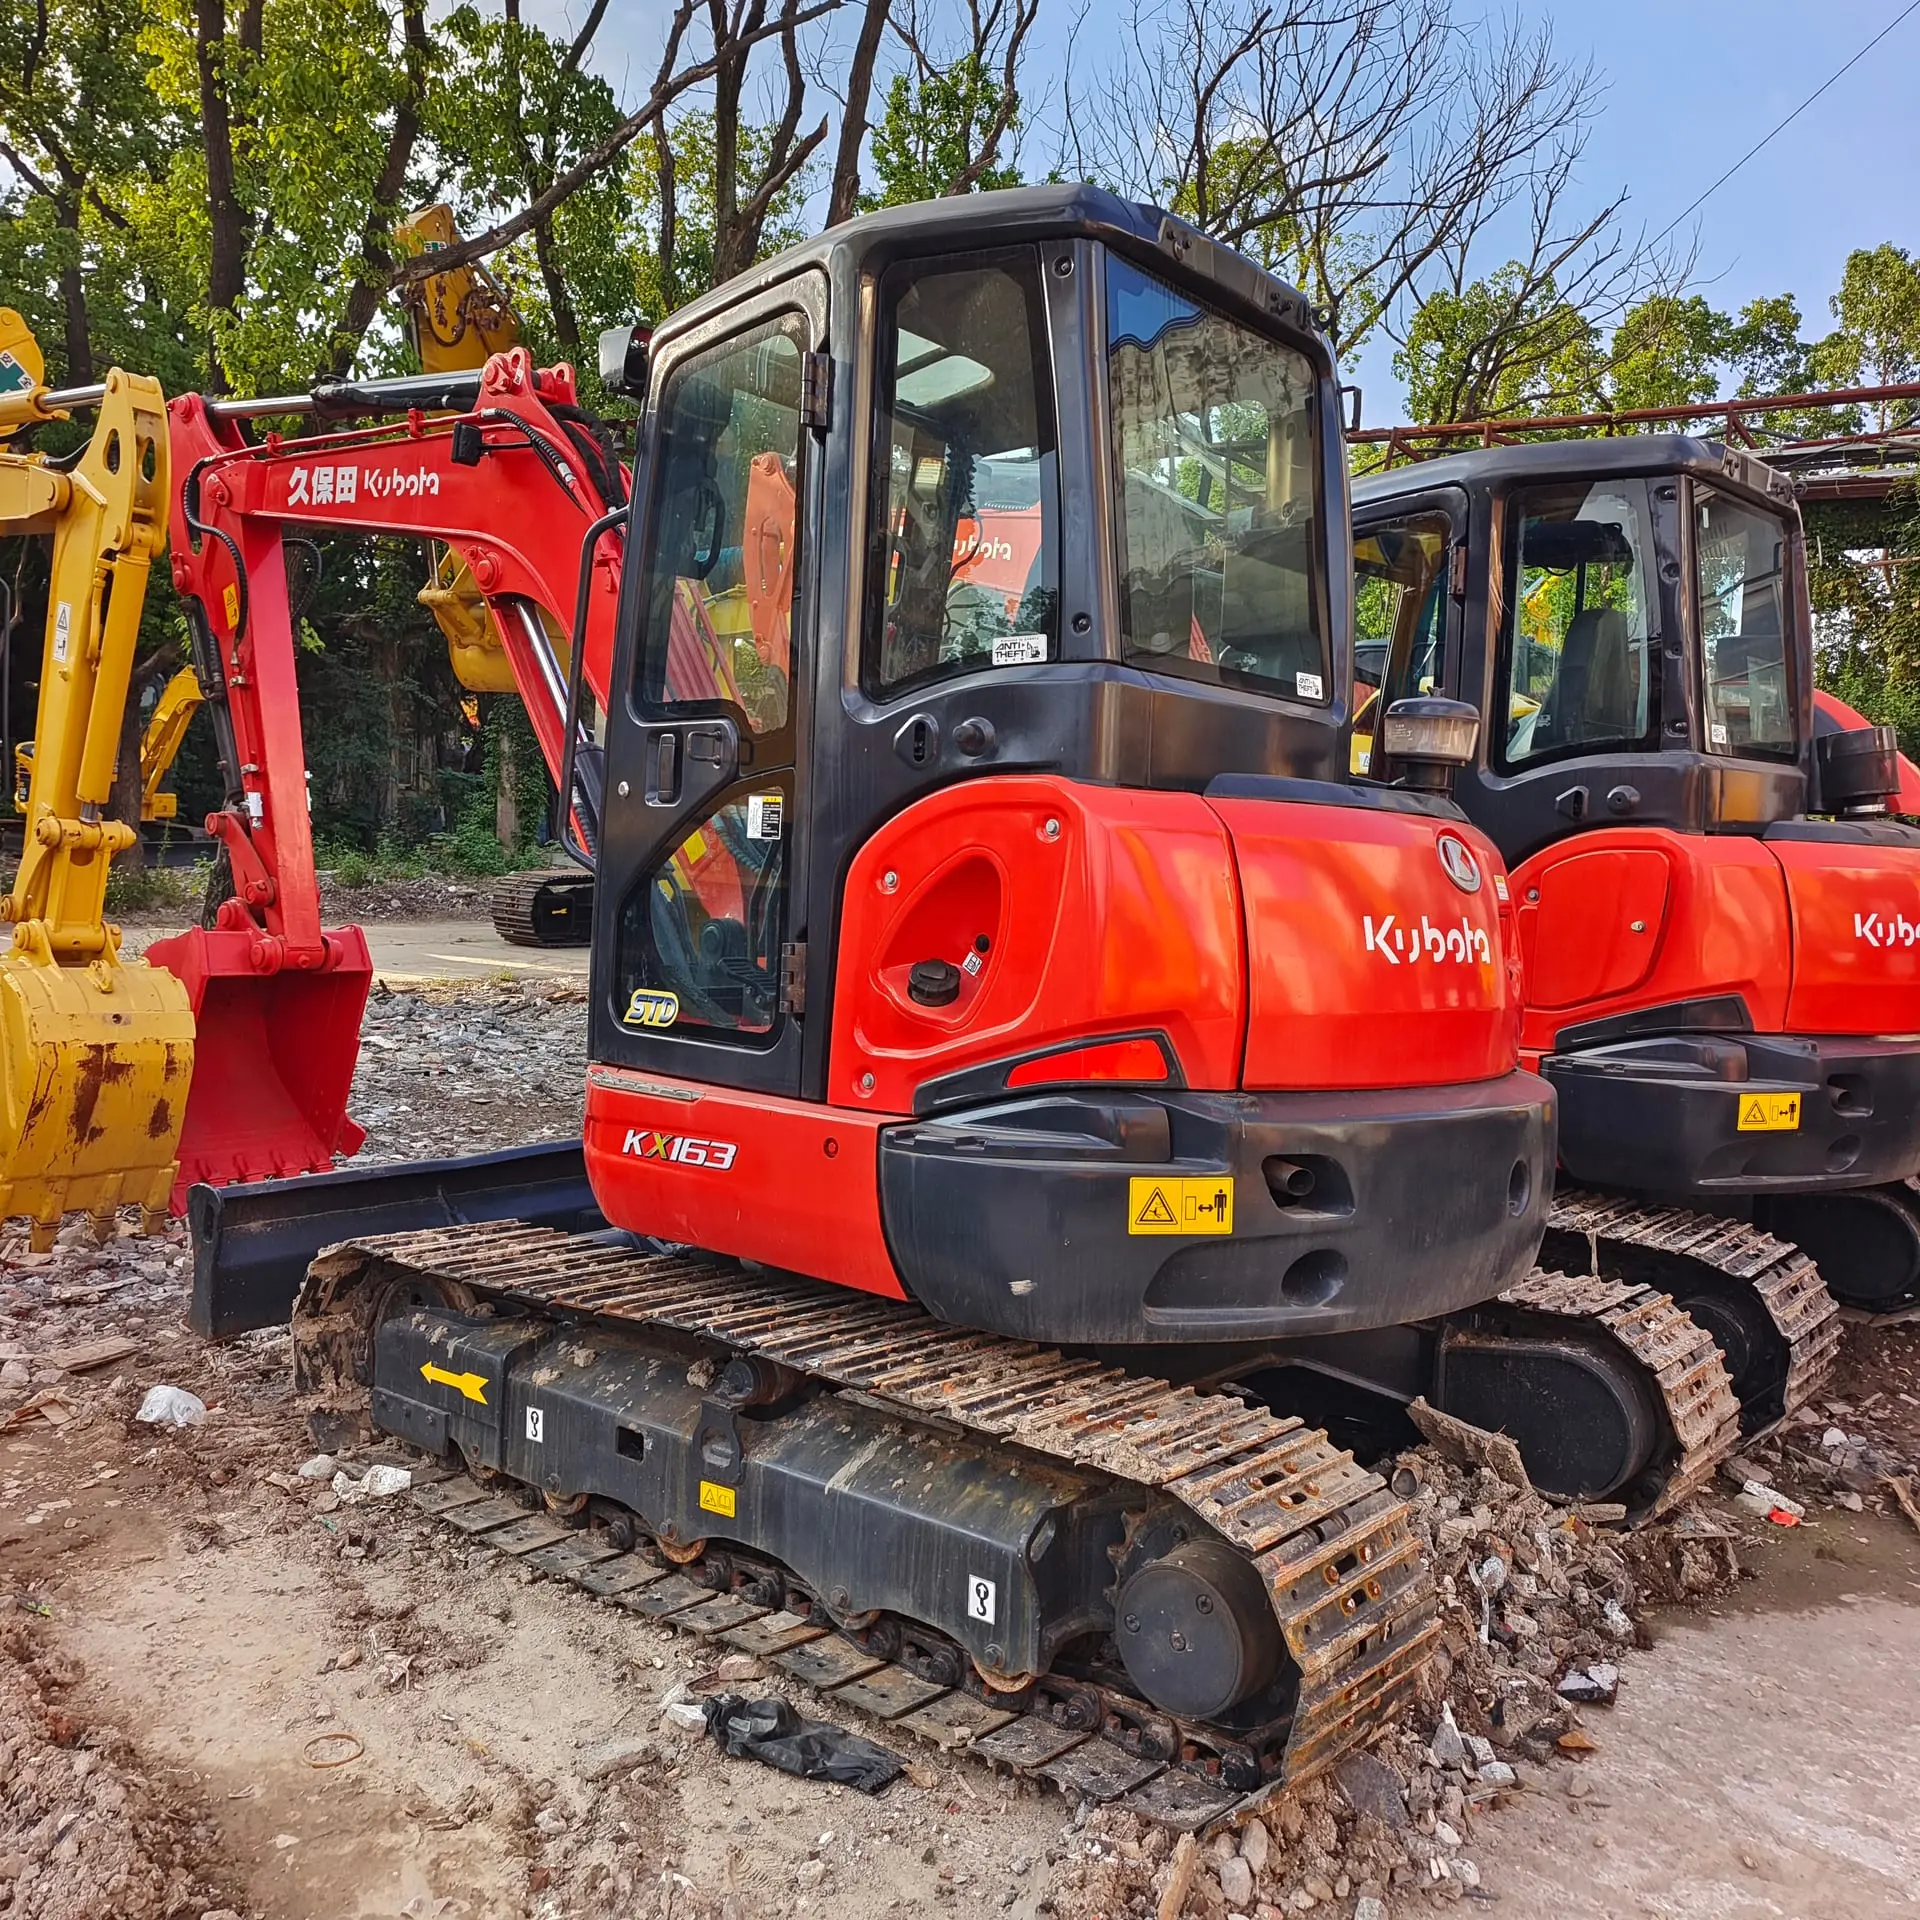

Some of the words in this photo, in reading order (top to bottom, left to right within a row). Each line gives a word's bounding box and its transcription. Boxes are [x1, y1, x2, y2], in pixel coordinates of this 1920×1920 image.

[288, 466, 358, 506] 久保田
[364, 466, 439, 497] Kubota
[954, 535, 1011, 560] ubota
[995, 650, 1025, 659] THEFT
[1363, 915, 1490, 964] Kubota
[629, 994, 676, 1022] STD
[622, 1129, 738, 1170] KX163
